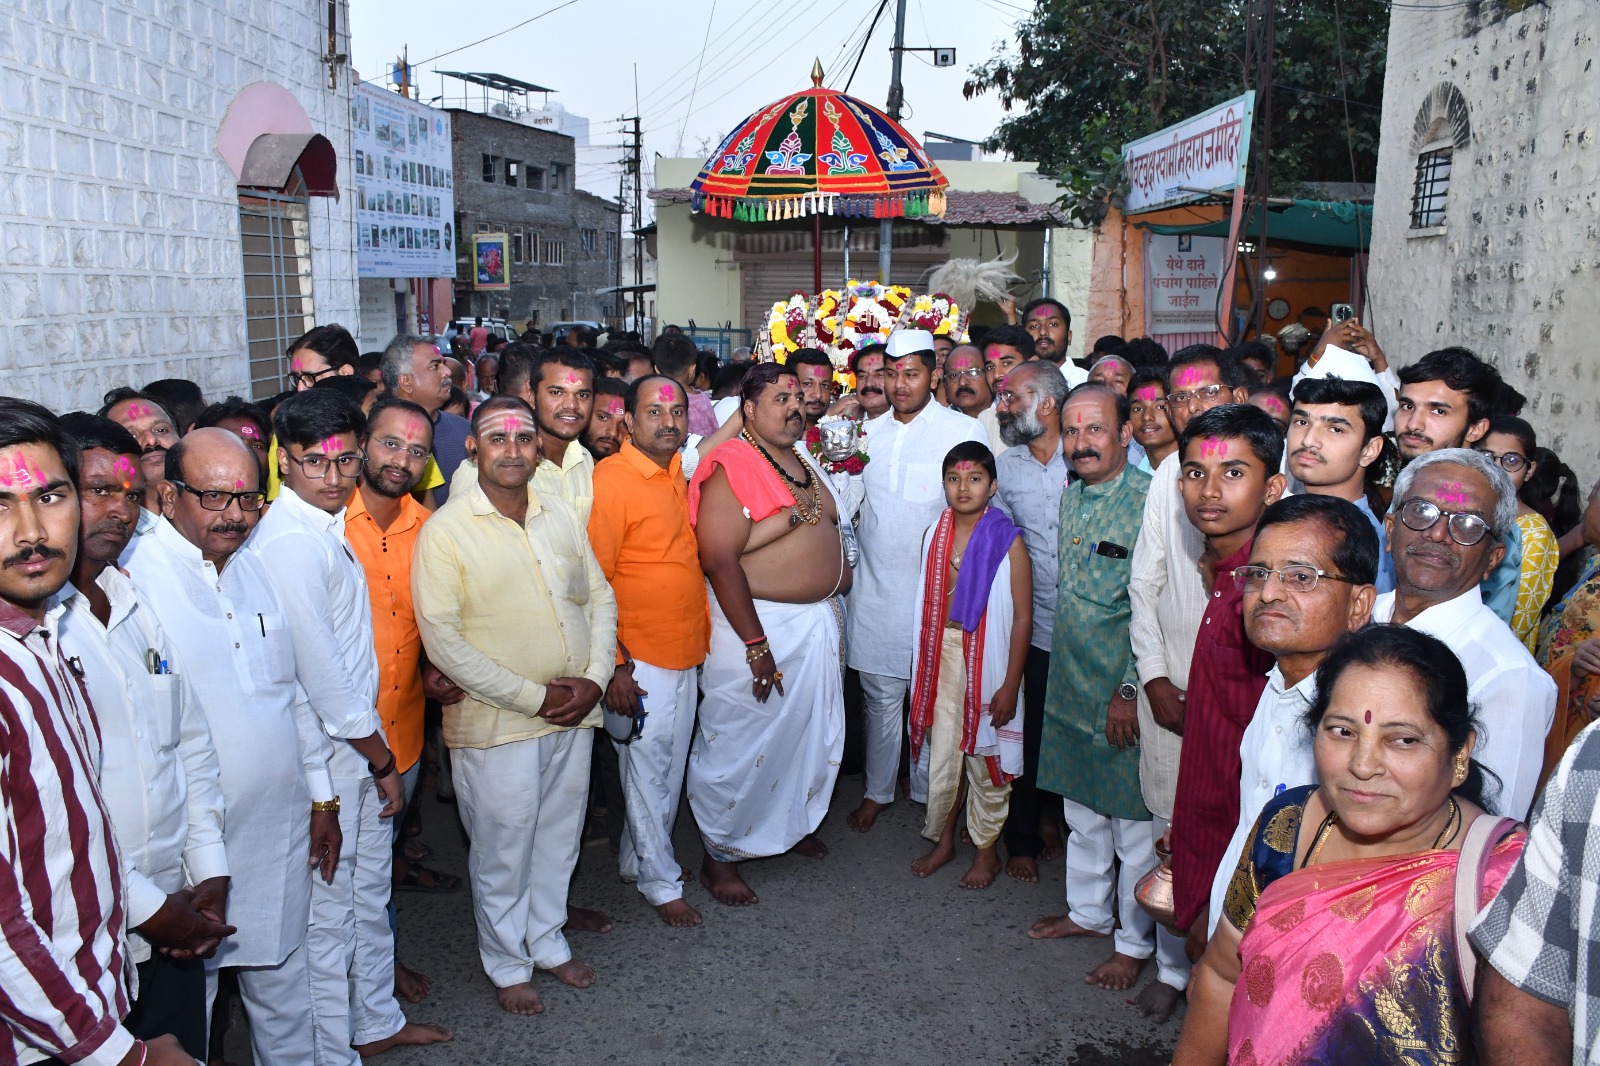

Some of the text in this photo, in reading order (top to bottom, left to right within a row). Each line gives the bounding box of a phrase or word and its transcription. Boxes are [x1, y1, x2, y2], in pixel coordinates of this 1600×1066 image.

[1156, 133, 1178, 183] स्वामी
[1178, 127, 1215, 180] महाराज
[1214, 108, 1242, 169] मंदिर
[1166, 255, 1205, 270] येथे दाते
[1153, 273, 1218, 289] पंचांग पाहिले
[1168, 290, 1199, 308] जाईल
